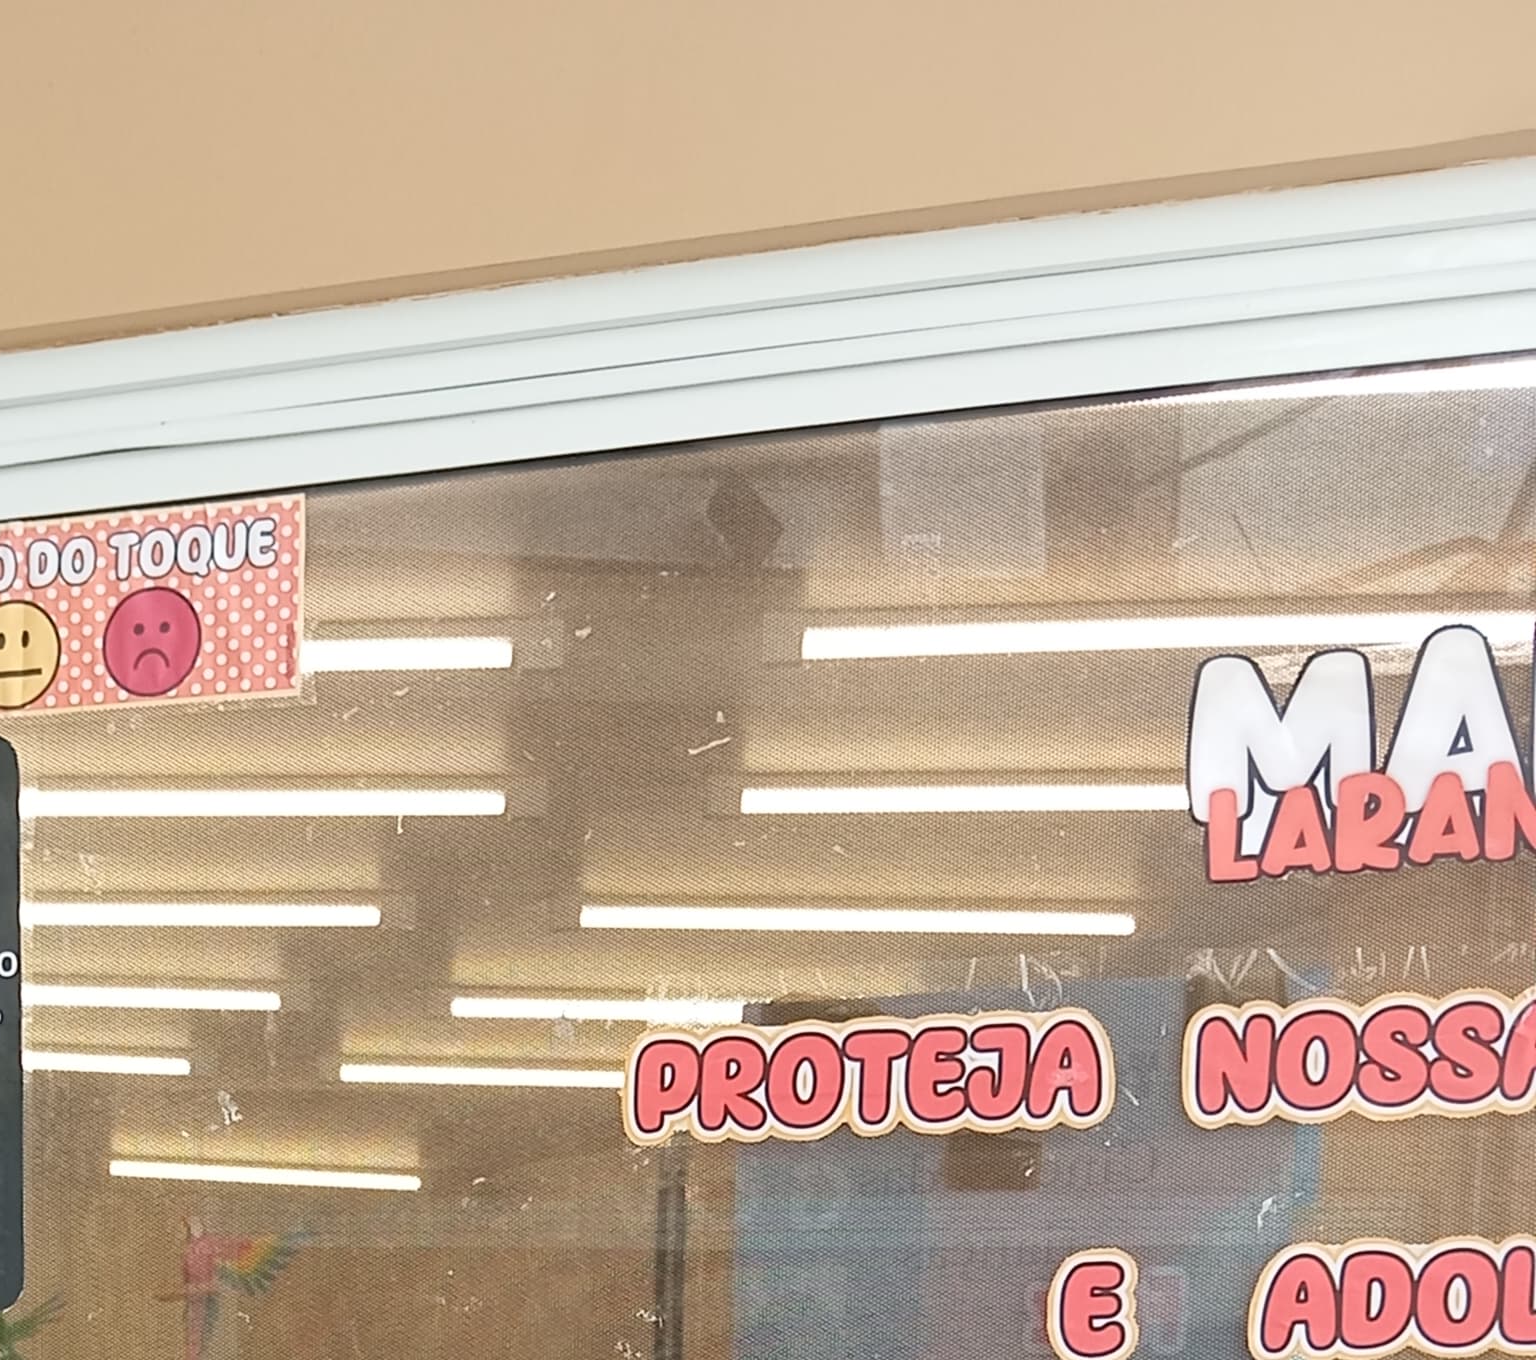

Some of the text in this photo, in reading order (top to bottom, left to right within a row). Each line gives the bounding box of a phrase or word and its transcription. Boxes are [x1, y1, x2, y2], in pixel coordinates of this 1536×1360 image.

[28, 536, 97, 588] DO
[109, 517, 278, 581] TOQUE
[1187, 623, 1536, 824] MA
[634, 1018, 1103, 1134] PROTEJA
[1062, 1258, 1127, 1358] E
